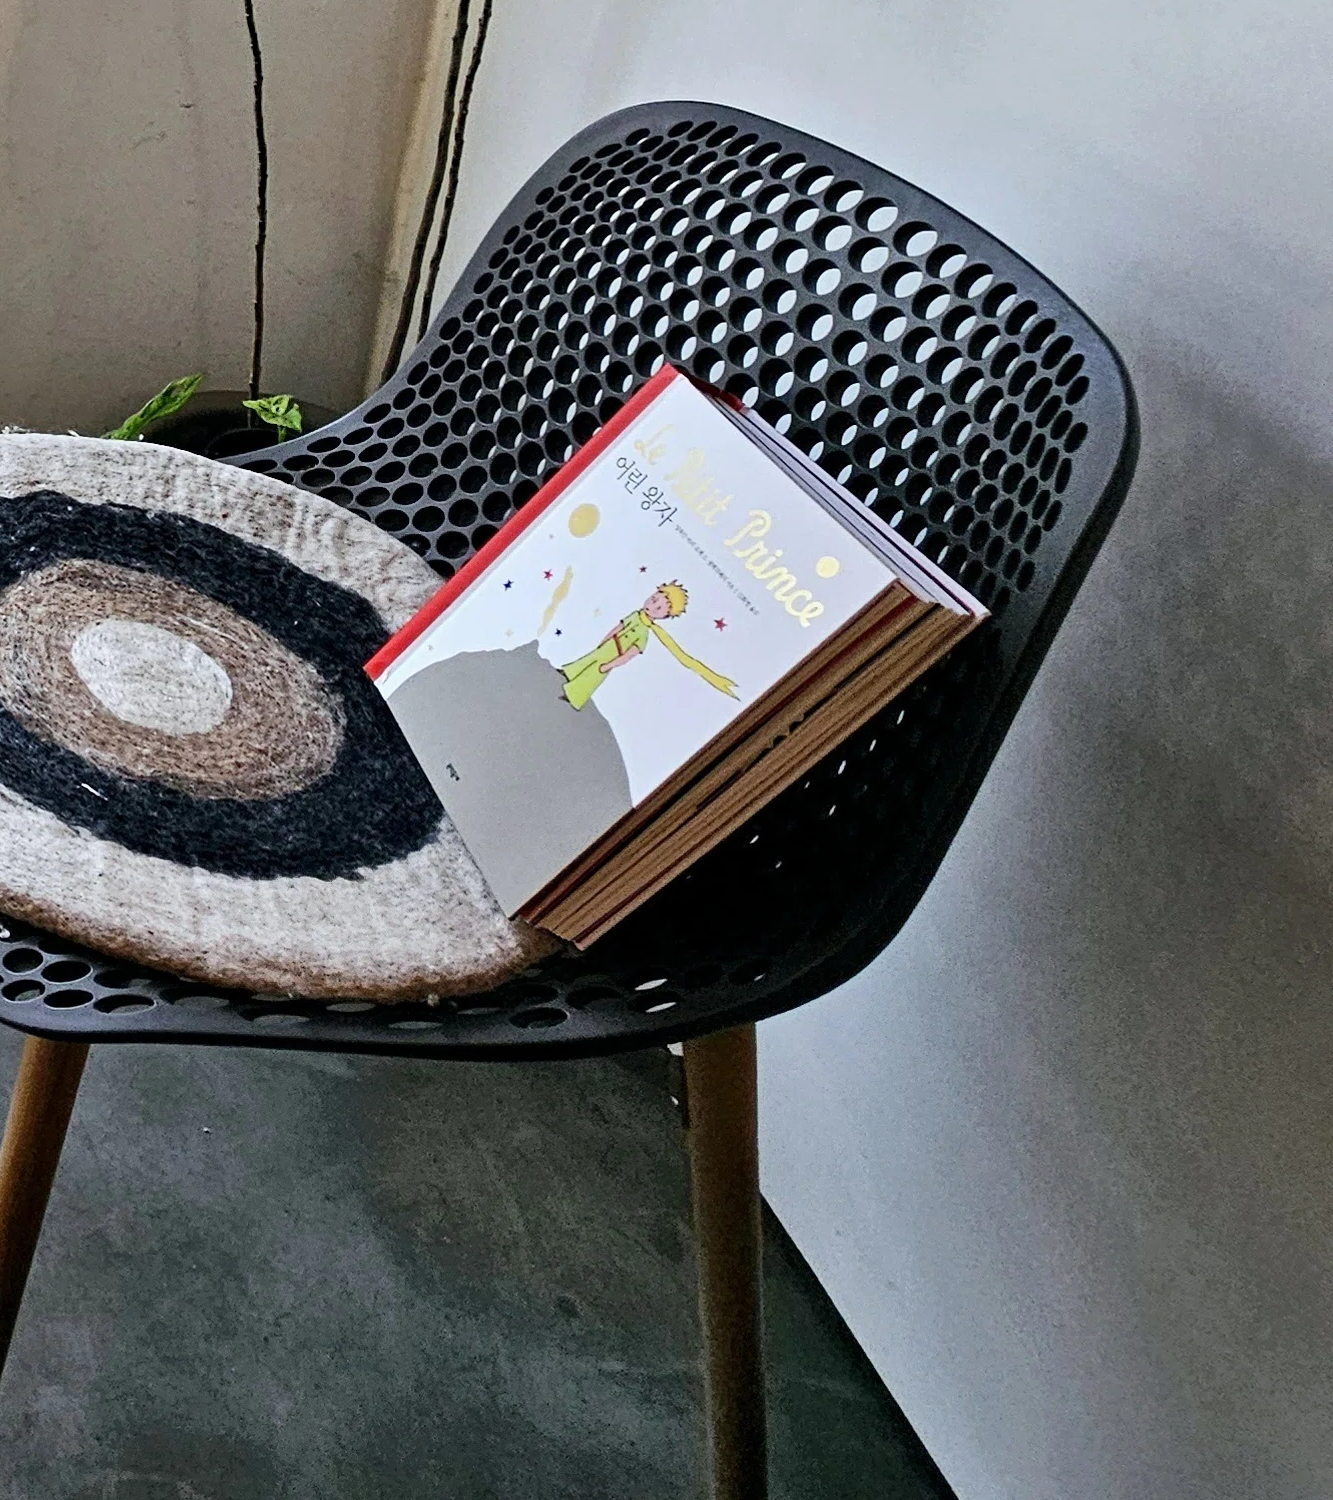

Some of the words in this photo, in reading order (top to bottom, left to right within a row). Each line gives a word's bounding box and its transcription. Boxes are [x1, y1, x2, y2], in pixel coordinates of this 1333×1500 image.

[615, 455, 649, 495] 어린
[639, 485, 679, 528] 왕자
[633, 422, 677, 467] Le
[663, 446, 734, 528] Petit
[723, 508, 825, 629] Prince
